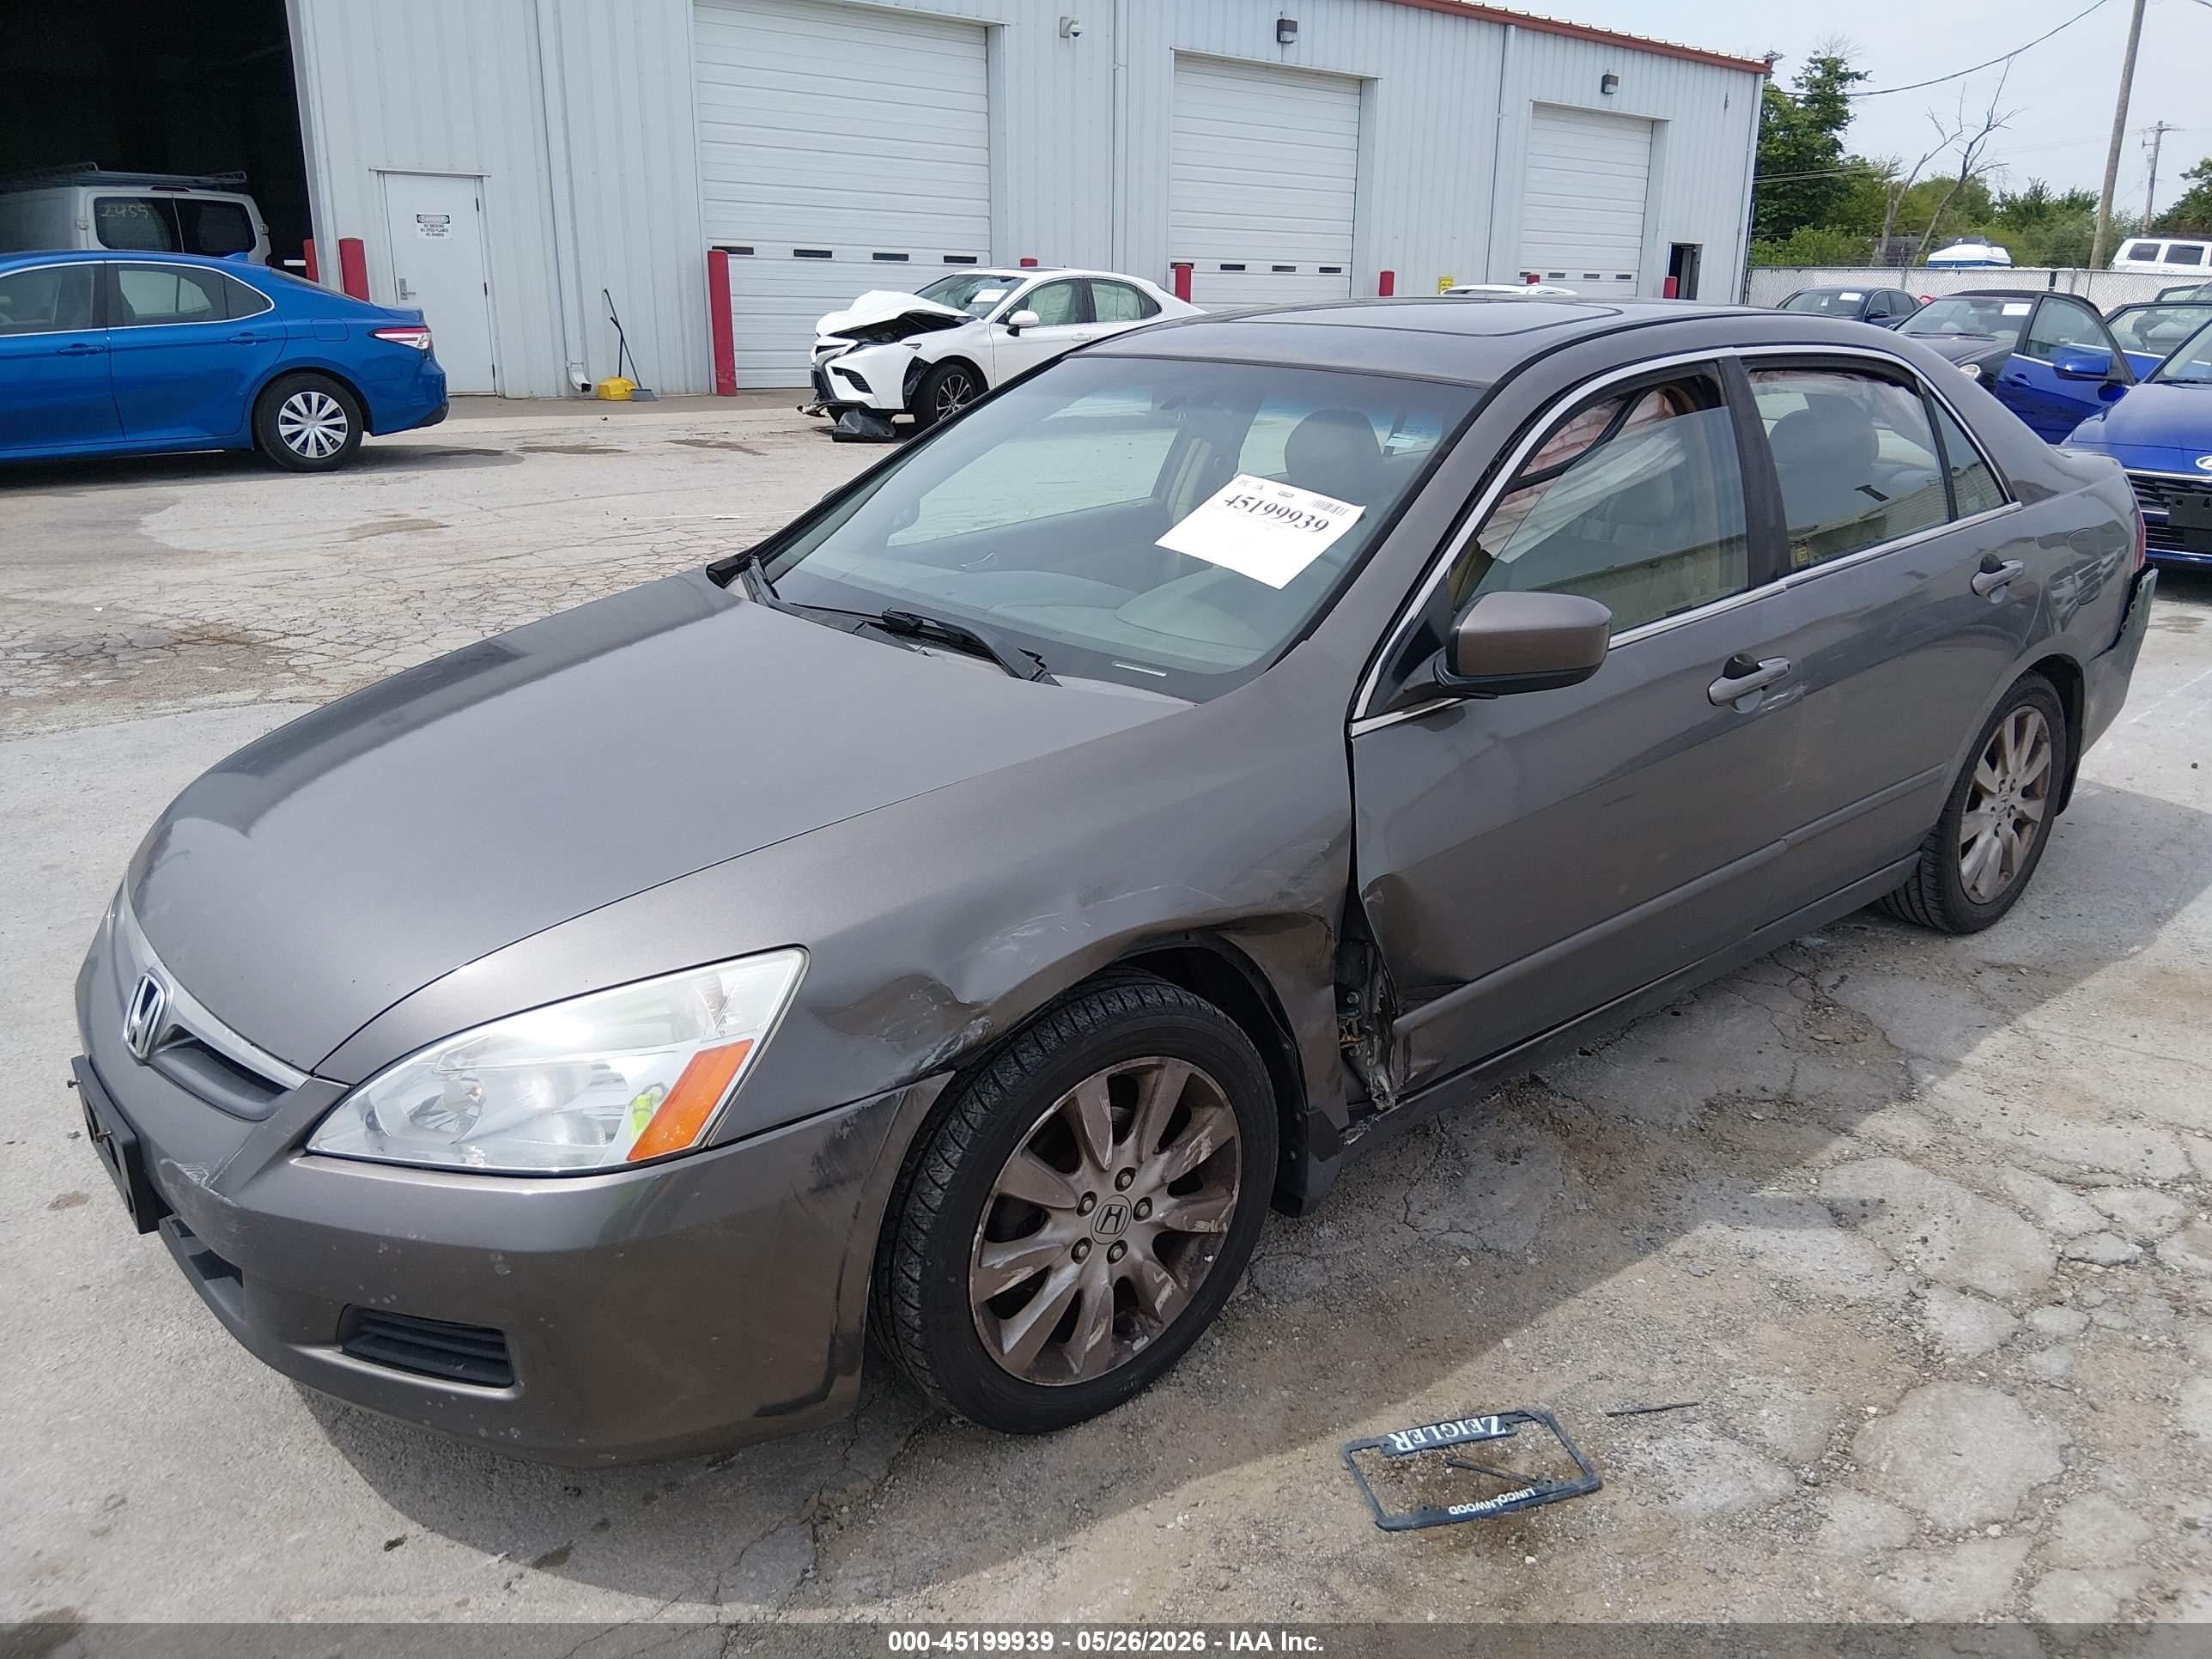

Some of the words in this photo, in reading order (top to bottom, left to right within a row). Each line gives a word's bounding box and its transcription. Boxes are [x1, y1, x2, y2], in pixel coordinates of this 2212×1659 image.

[1224, 494, 1330, 532] 45199939
[1389, 1415, 1507, 1452] ZEIGLER
[1448, 1487, 1535, 1516] LINCOLNWOOD
